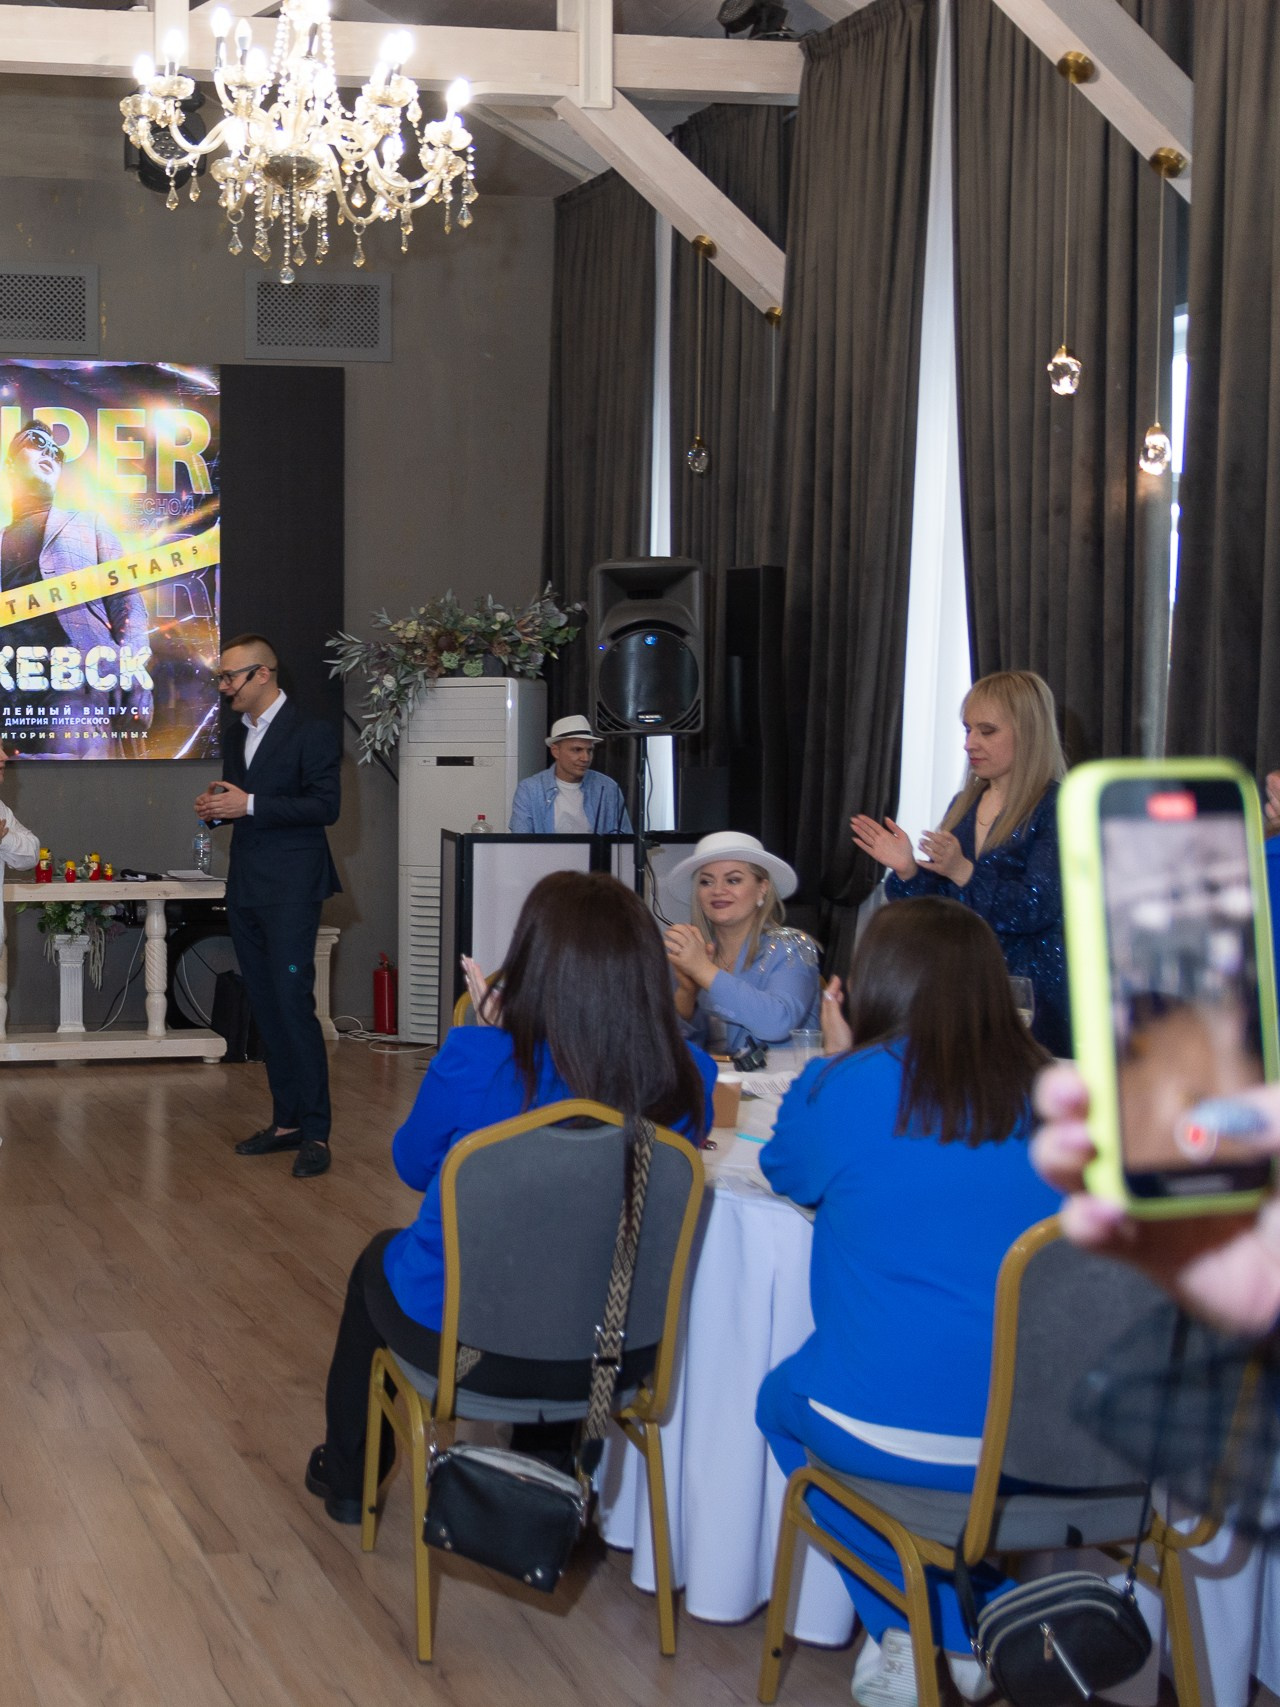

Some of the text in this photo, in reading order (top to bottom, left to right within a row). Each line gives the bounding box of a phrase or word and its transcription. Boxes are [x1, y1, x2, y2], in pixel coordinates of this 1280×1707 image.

[83, 706, 150, 716] ВЫПУСК
[5, 717, 110, 727] ДМИТРИЯ ПИТЕРСКОГО
[64, 731, 148, 739] ИЗБРАННЫХ
